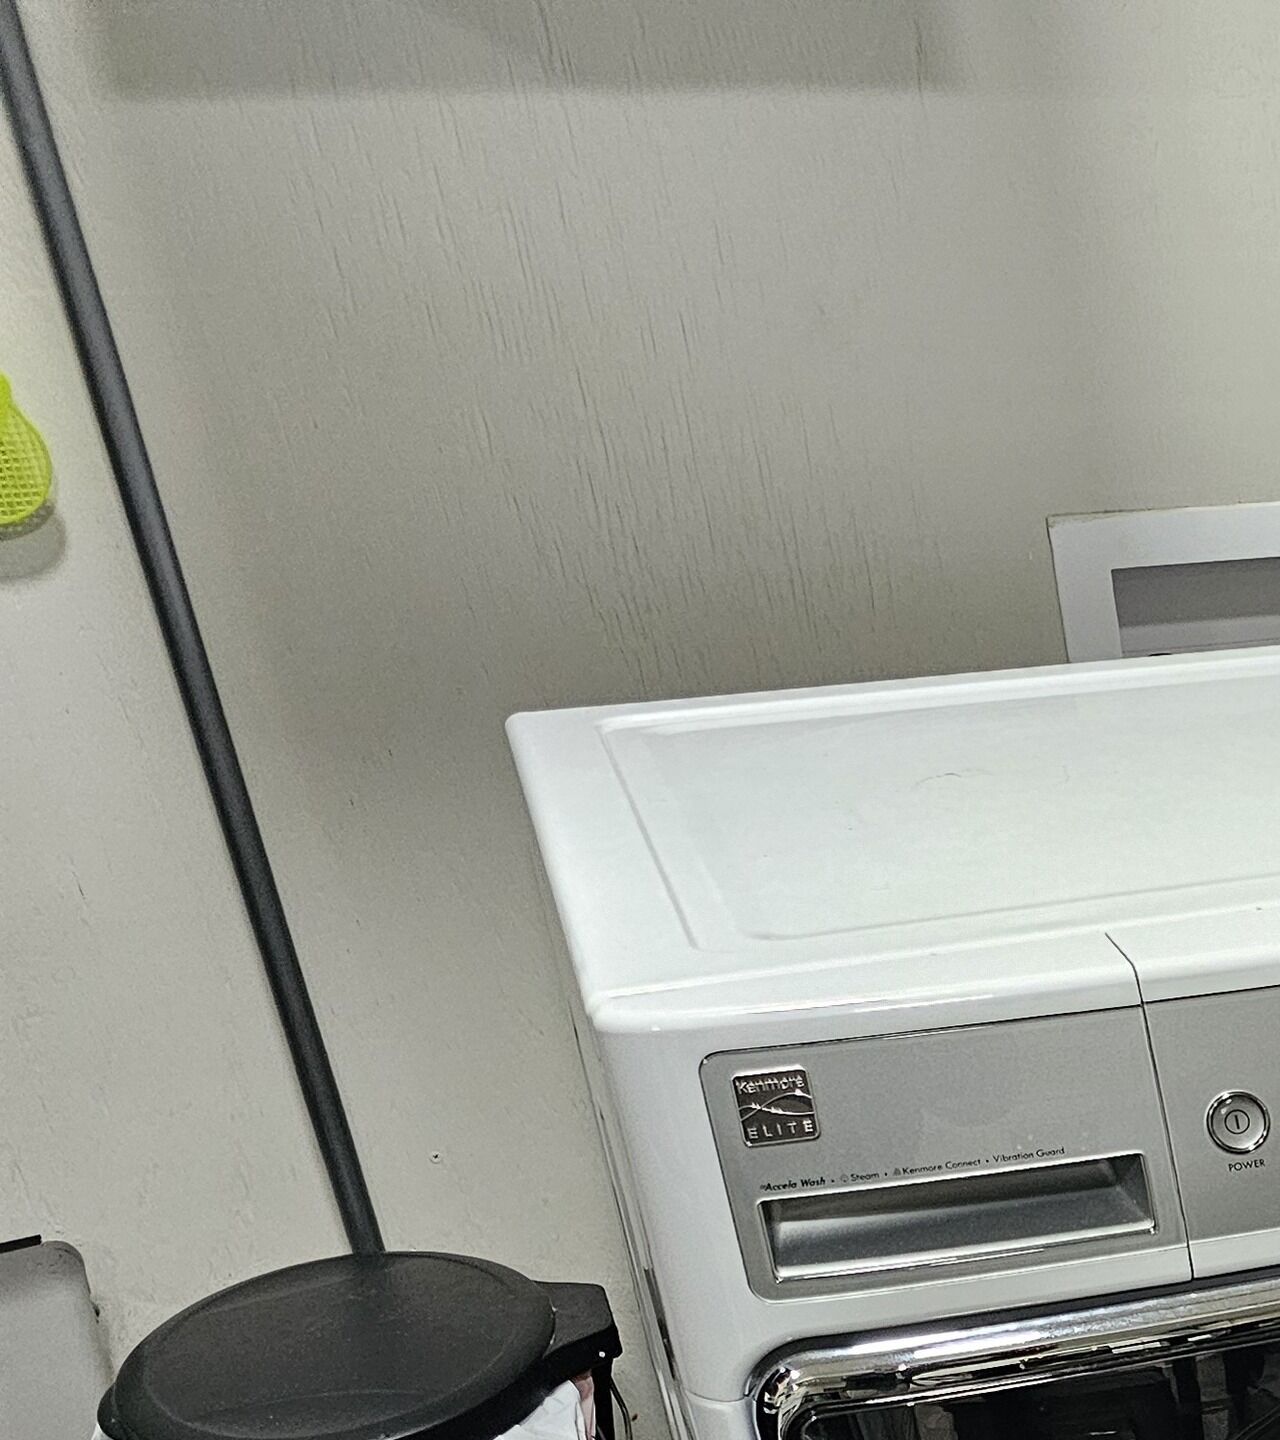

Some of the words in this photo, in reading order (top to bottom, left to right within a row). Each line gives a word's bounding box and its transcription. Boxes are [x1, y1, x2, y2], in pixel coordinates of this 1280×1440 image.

[736, 1075, 805, 1095] Kenmore
[747, 1119, 813, 1140] ELITE
[992, 1152, 1034, 1164] Vibration
[1035, 1146, 1066, 1158] Guard
[902, 1164, 943, 1176] Kenmore
[944, 1158, 982, 1170] Connect
[1228, 1159, 1266, 1173] POWER
[800, 1176, 826, 1188] Wash
[850, 1172, 880, 1182] Steam
